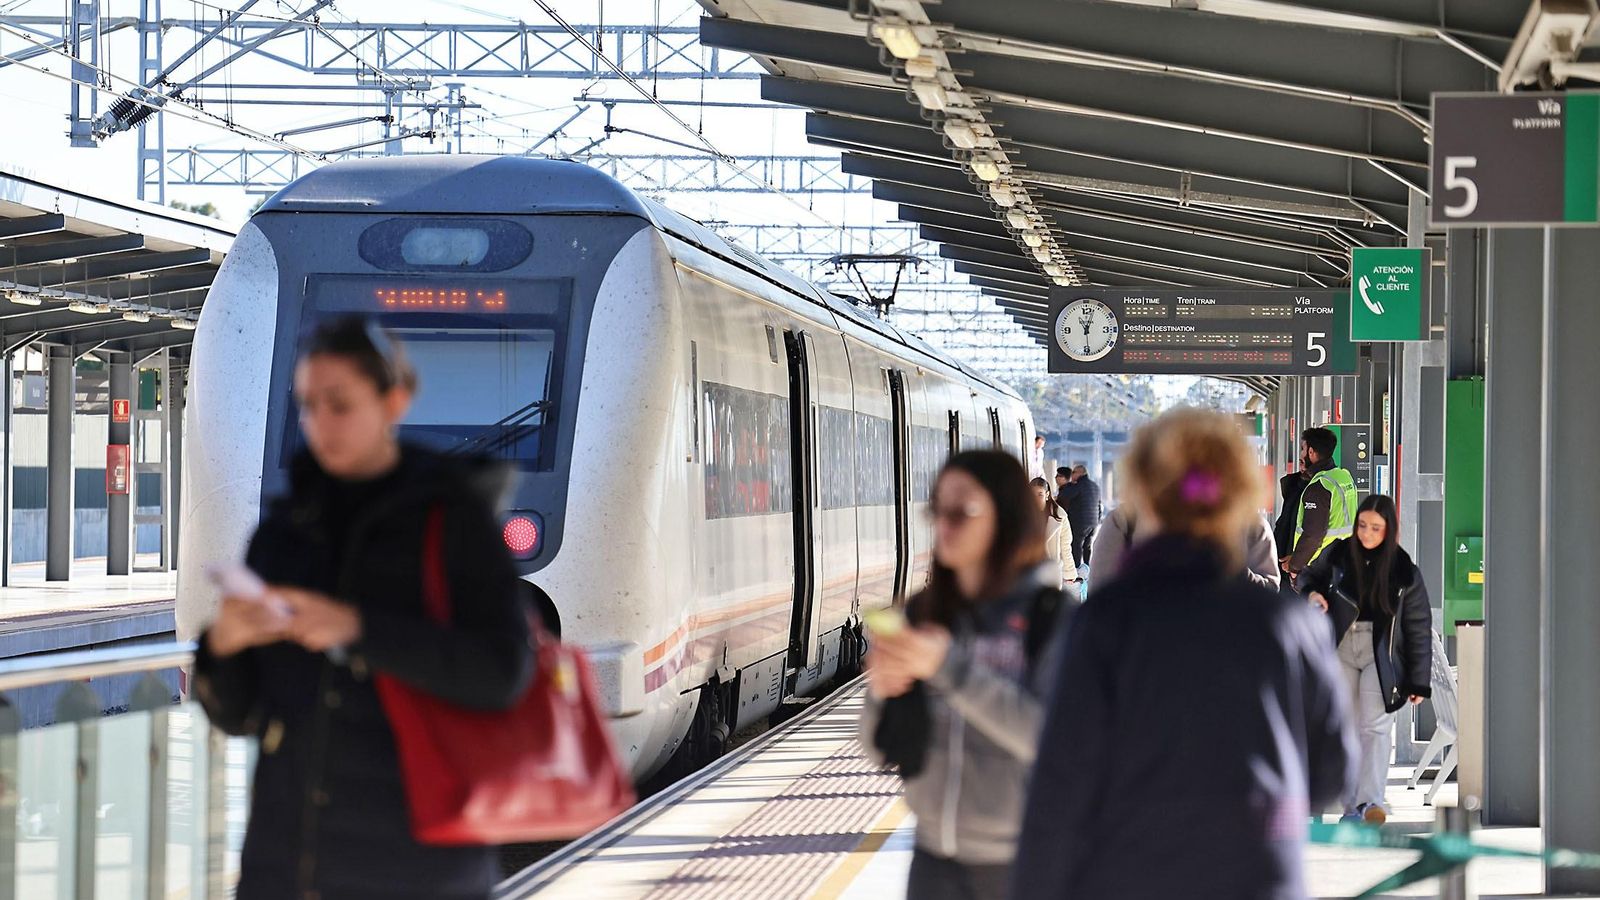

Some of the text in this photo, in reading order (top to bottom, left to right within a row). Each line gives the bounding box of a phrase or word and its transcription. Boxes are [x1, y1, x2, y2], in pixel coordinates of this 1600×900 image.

[1444, 156, 1478, 218] 5
[1373, 266, 1413, 274] ATENCIÓN
[1376, 283, 1410, 291] CLIENTE
[1295, 296, 1311, 305] Vía
[1081, 307, 1092, 315] 12
[1064, 326, 1071, 334] 9
[1306, 332, 1327, 367] 5
